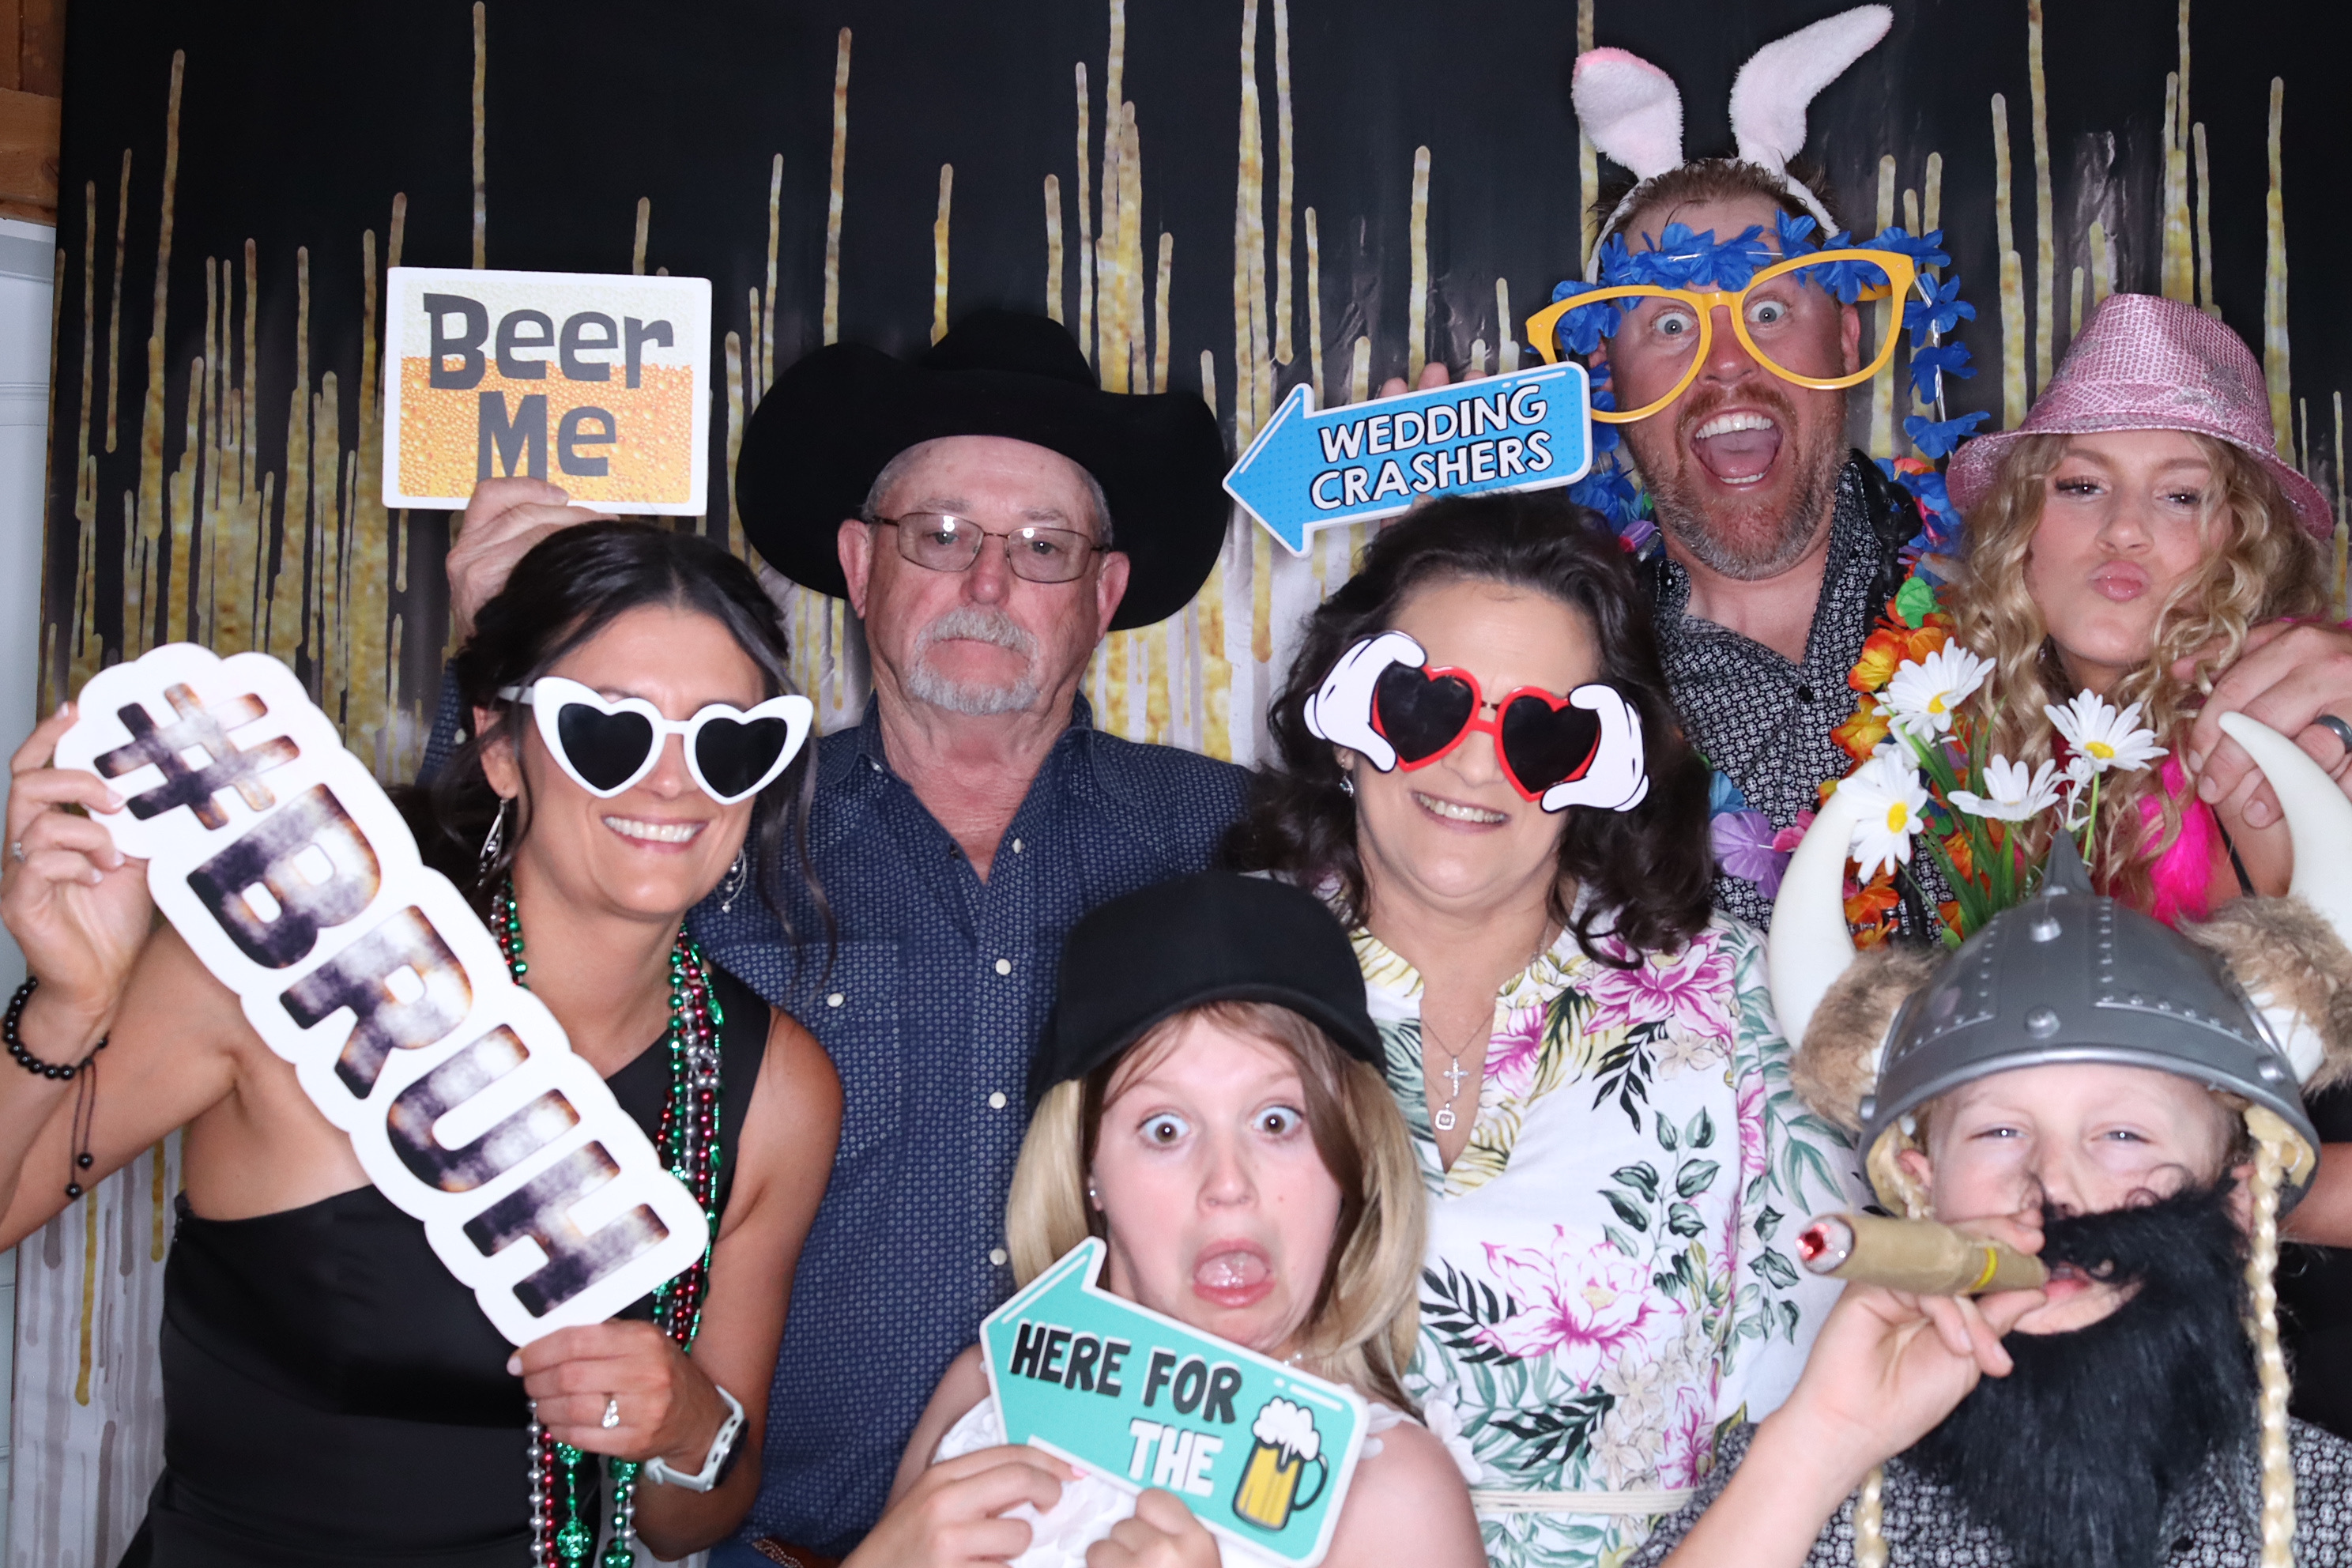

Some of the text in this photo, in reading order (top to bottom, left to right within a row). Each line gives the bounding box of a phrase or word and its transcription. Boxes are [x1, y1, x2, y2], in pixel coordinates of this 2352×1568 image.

[423, 292, 674, 390] Beer
[477, 390, 616, 483] Me
[1310, 431, 1553, 510] CRASHERS
[1318, 385, 1547, 463] WEDDING
[92, 682, 670, 1318] #BRUH
[1009, 1321, 1242, 1424] HERE FOR
[1129, 1417, 1224, 1497] THE
